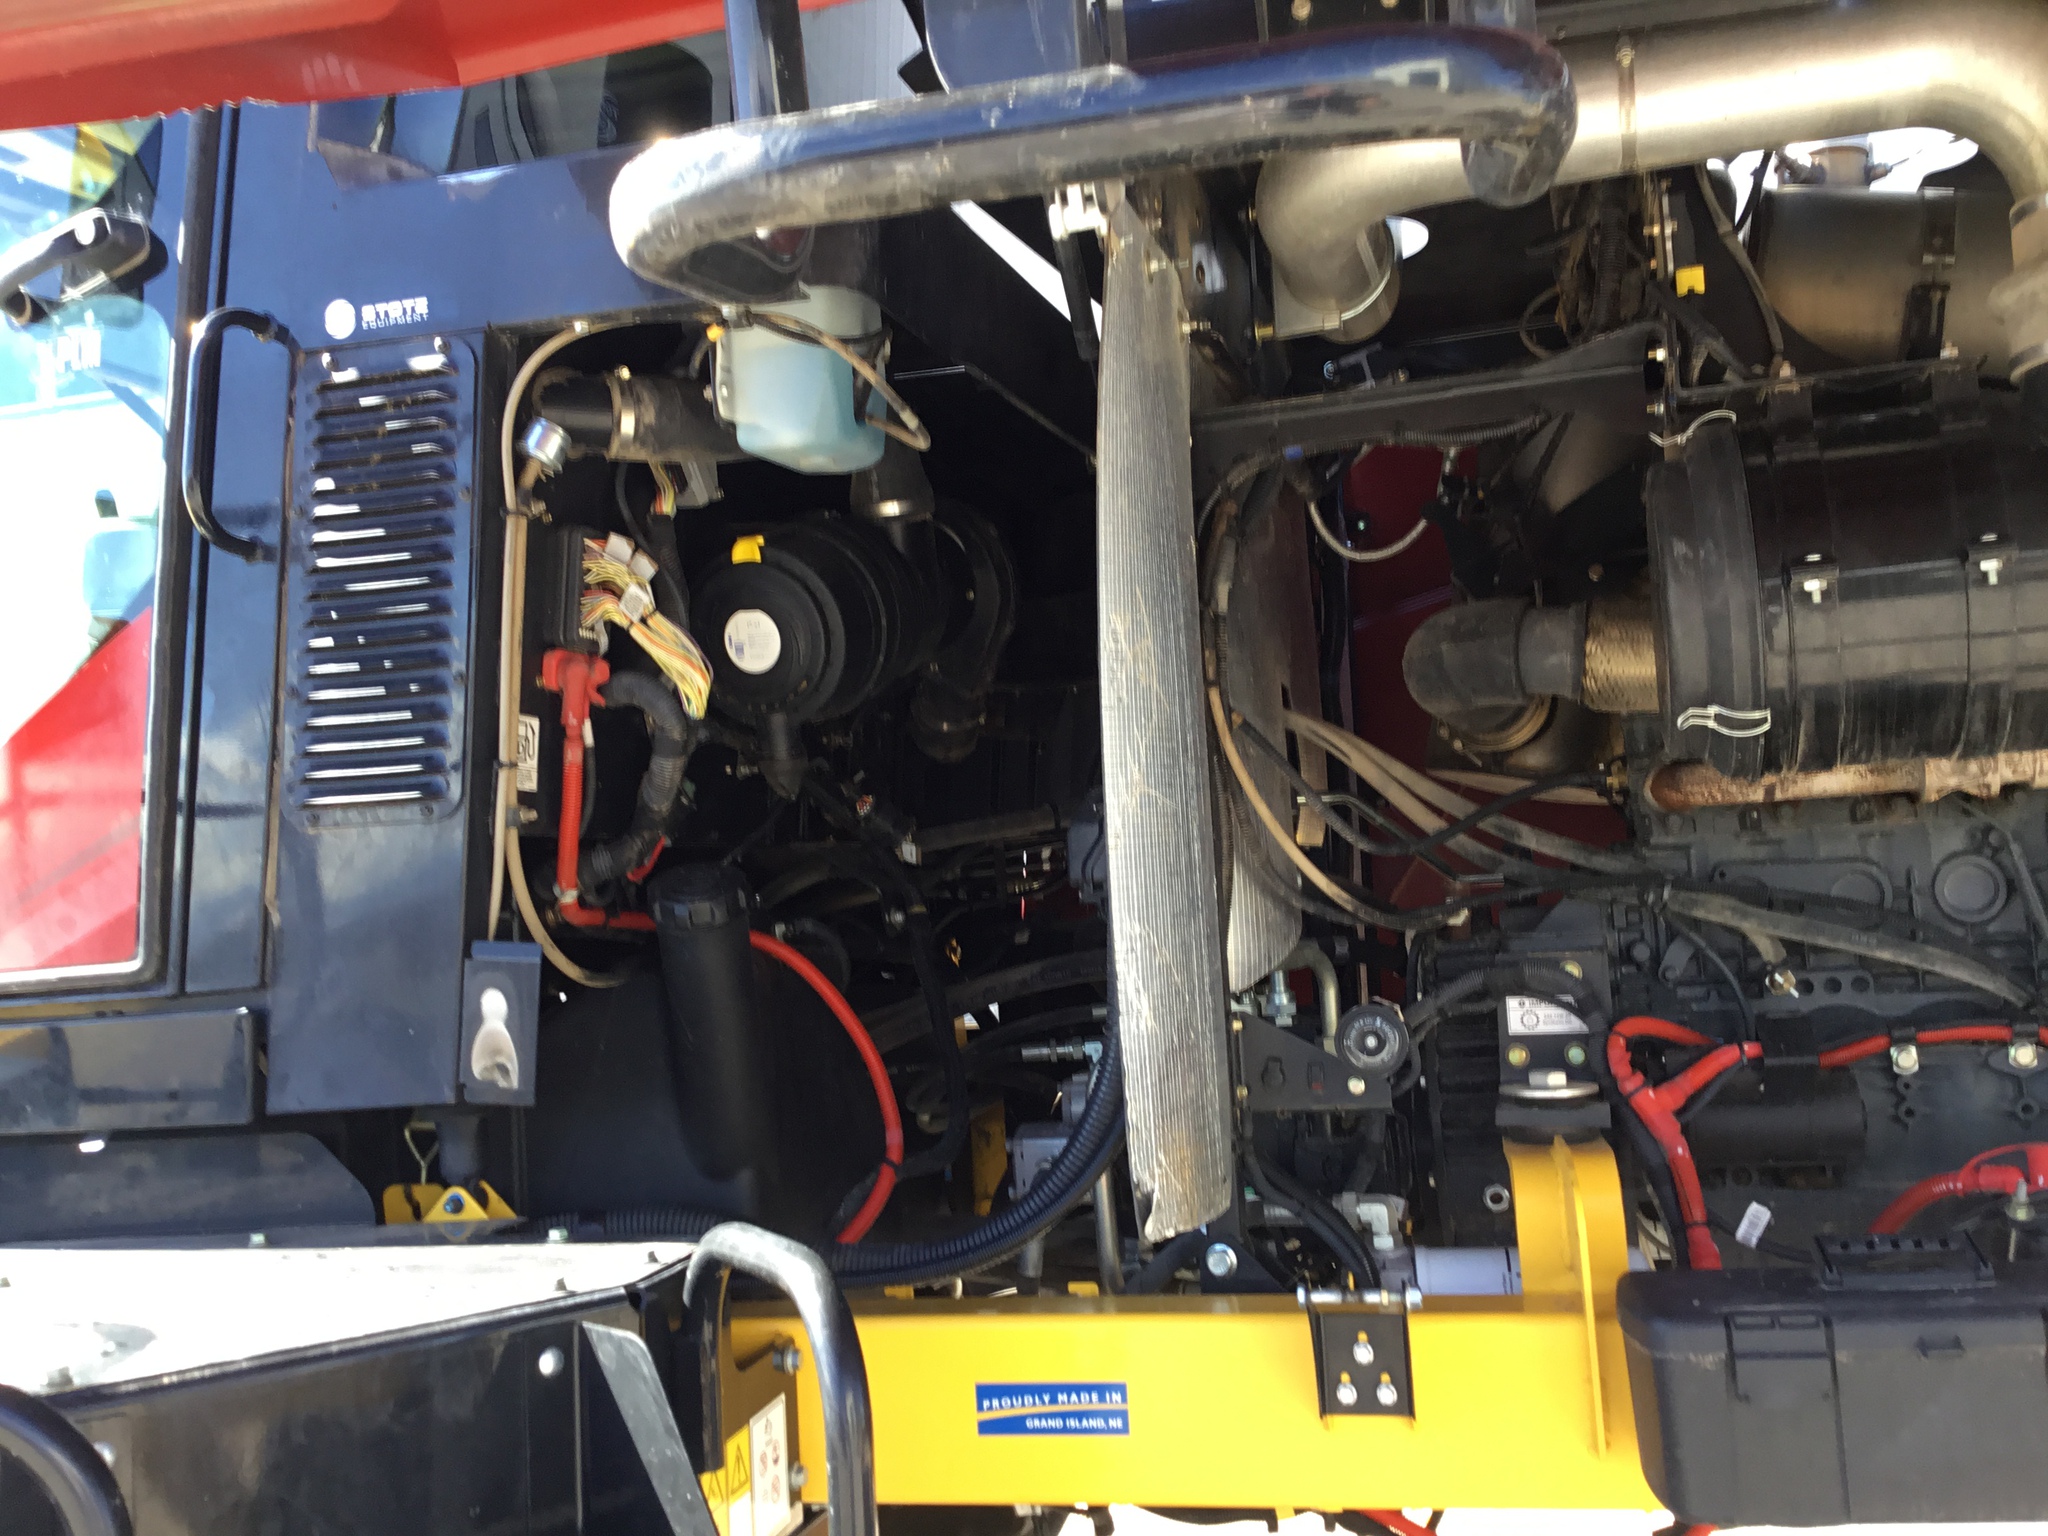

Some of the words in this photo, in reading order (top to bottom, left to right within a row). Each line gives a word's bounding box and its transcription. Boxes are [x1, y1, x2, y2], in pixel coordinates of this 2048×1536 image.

[361, 312, 429, 330] EQUIPMENT
[982, 1392, 1051, 1412] PROUDLY
[1057, 1390, 1100, 1405] MADE
[1105, 1390, 1122, 1405] IN
[1025, 1416, 1064, 1430] GRAND
[1065, 1416, 1108, 1431] ISLAND,
[1108, 1416, 1124, 1430] NE
